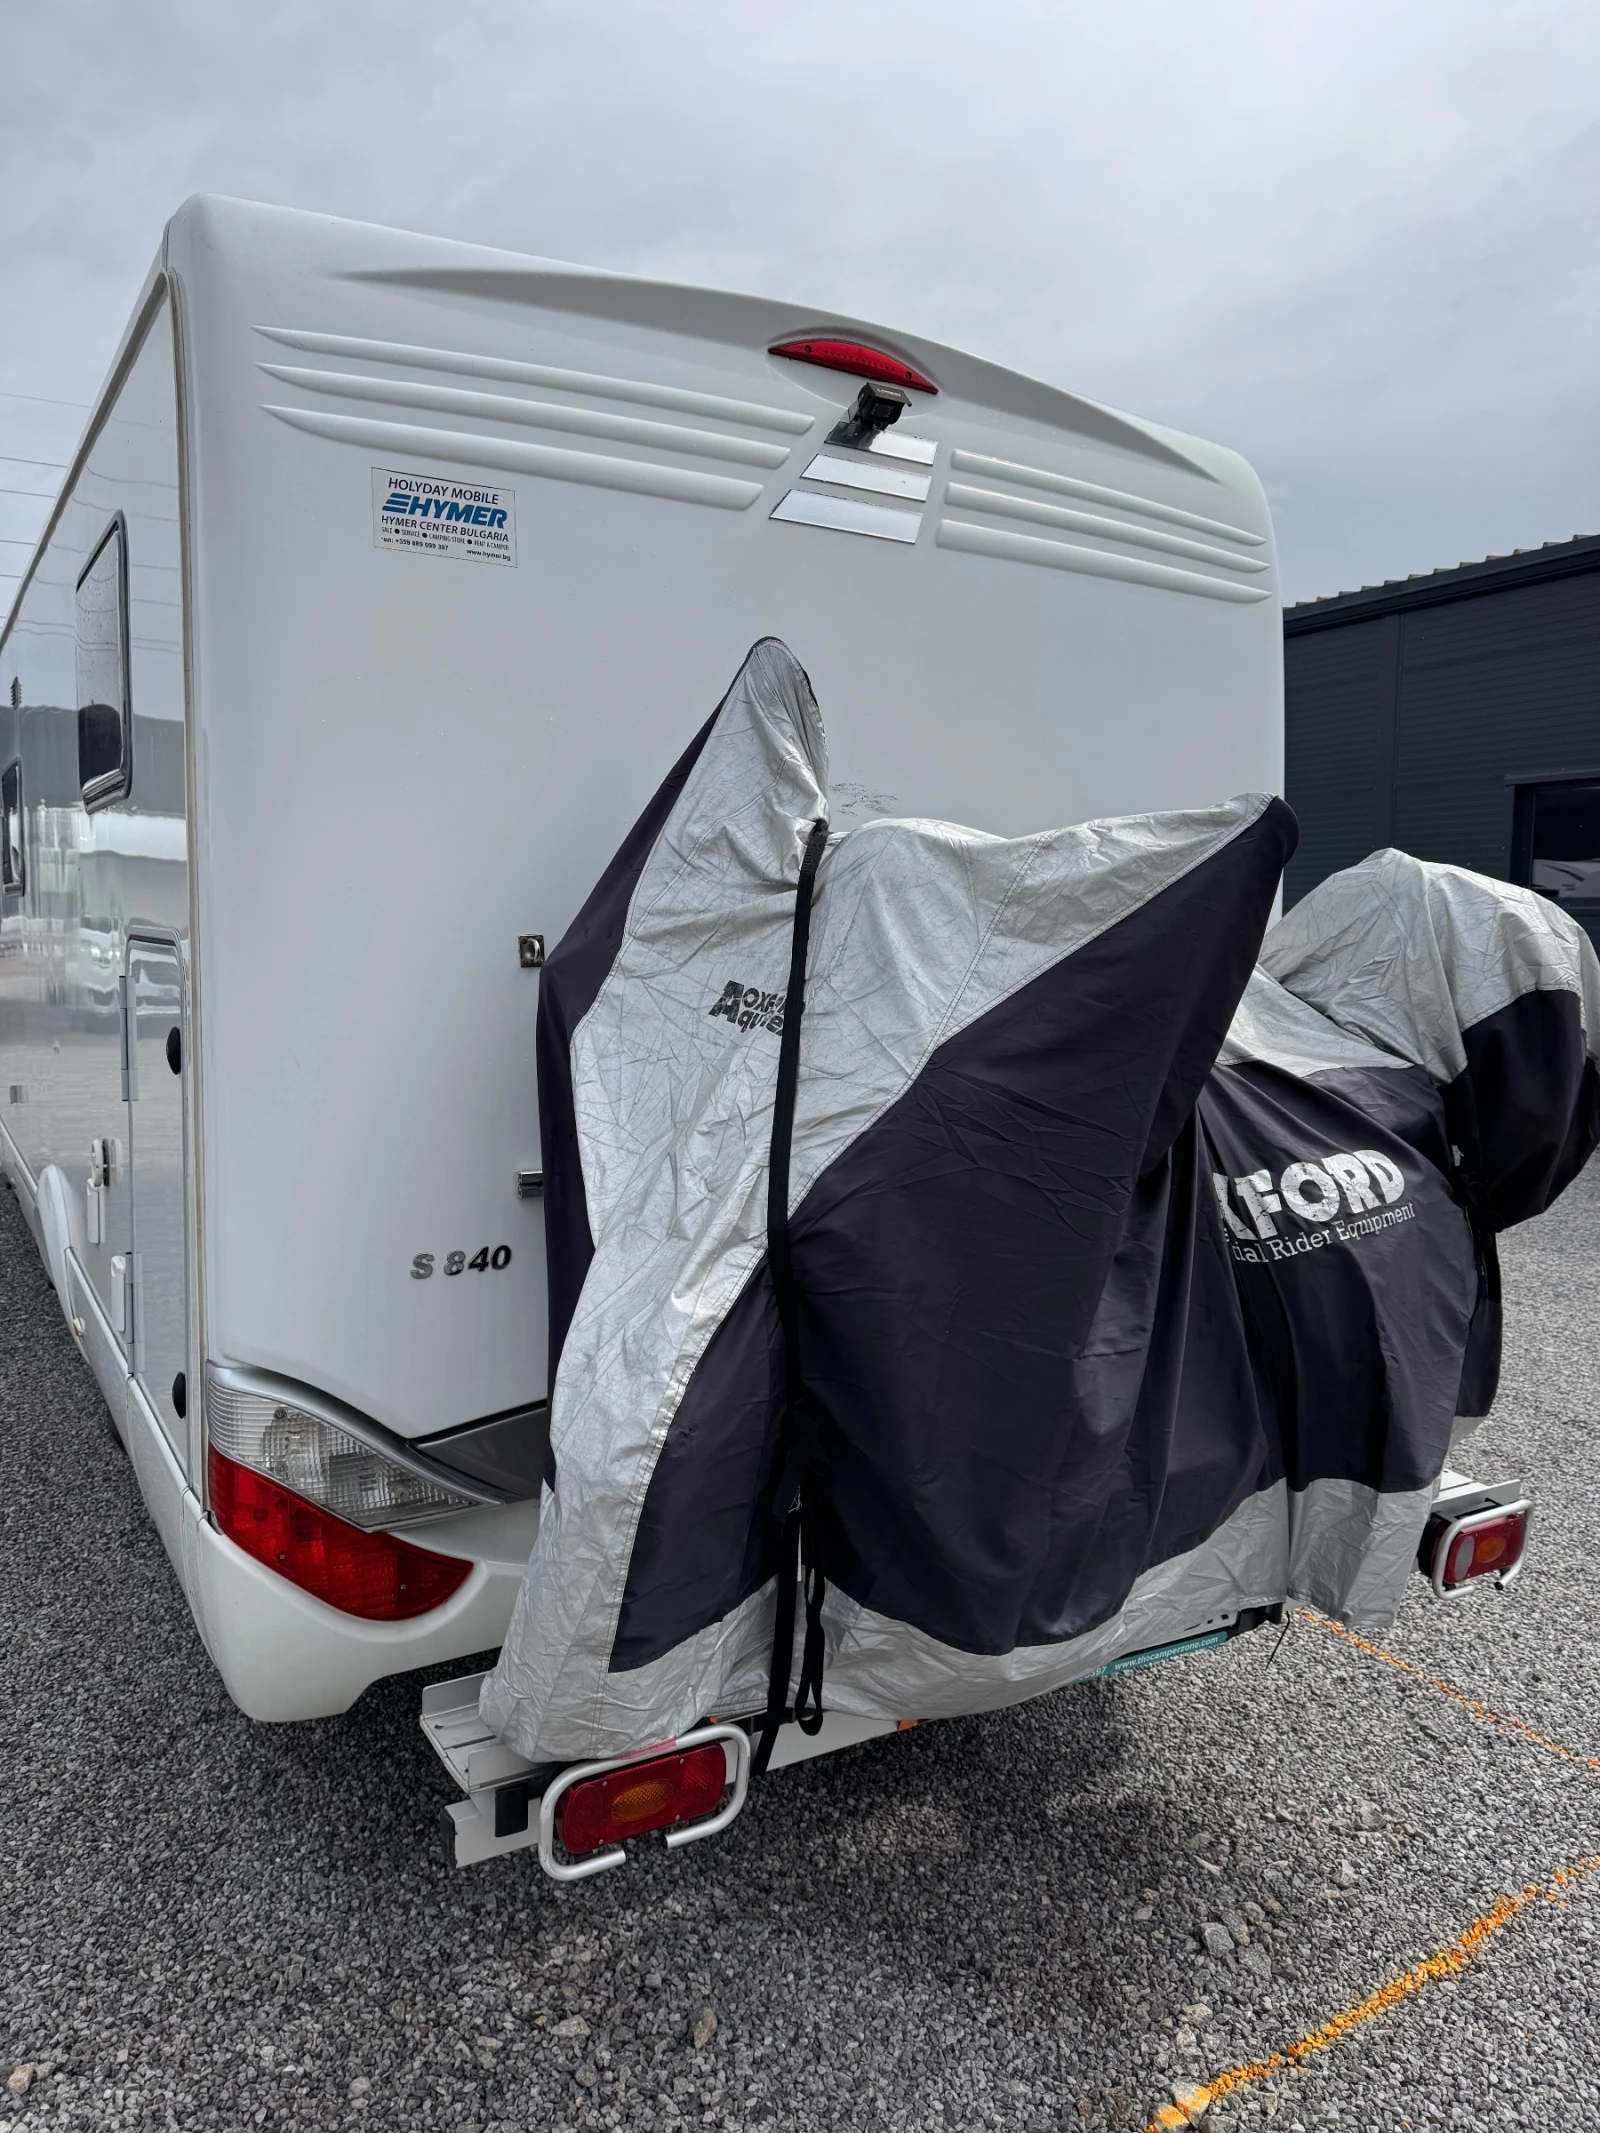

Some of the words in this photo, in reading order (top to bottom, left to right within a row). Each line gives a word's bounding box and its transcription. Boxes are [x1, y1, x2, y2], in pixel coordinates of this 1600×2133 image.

[388, 477, 449, 497] HOLYDAY
[451, 488, 499, 505] MOBILE
[381, 515, 417, 529] HYMER
[419, 521, 458, 535] CENTER
[460, 527, 509, 542] BULGARIA
[407, 495, 508, 529] HYMER
[1266, 1228, 1333, 1261] Rider
[1332, 1201, 1416, 1241] Equipment
[410, 1253, 435, 1279] S
[443, 1244, 512, 1276] 840
